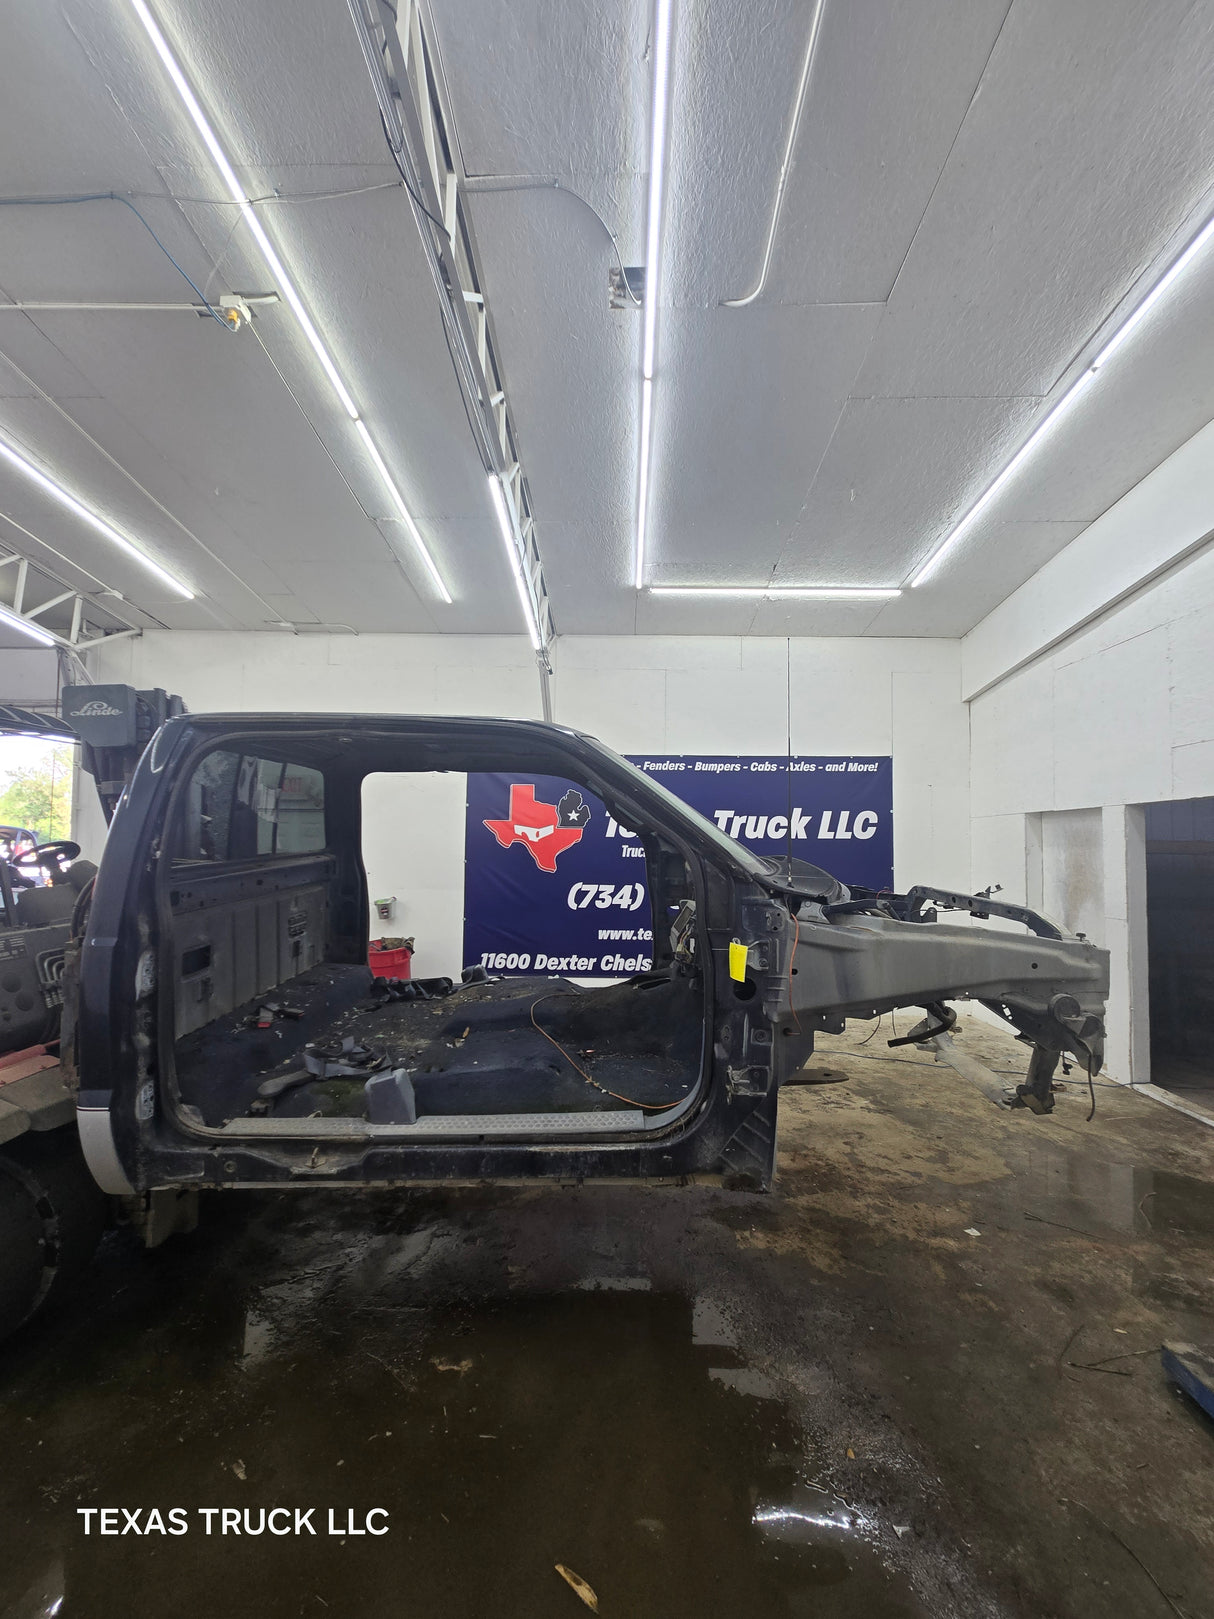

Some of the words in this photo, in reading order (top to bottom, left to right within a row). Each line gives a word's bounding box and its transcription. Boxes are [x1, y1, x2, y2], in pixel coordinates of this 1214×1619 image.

[70, 701, 123, 717] Linde
[643, 760, 686, 771] Fenders
[695, 761, 741, 773] Bumpers
[750, 762, 777, 772] Cabs
[786, 761, 816, 772] Axles
[825, 761, 846, 772] and
[847, 762, 879, 772] More!
[713, 807, 812, 840] Truck
[817, 810, 879, 840] LLC
[621, 844, 646, 858] Truc
[567, 882, 645, 911] (734)
[598, 928, 653, 941] www.te
[480, 952, 531, 970] 11600
[534, 953, 597, 971] Dexter
